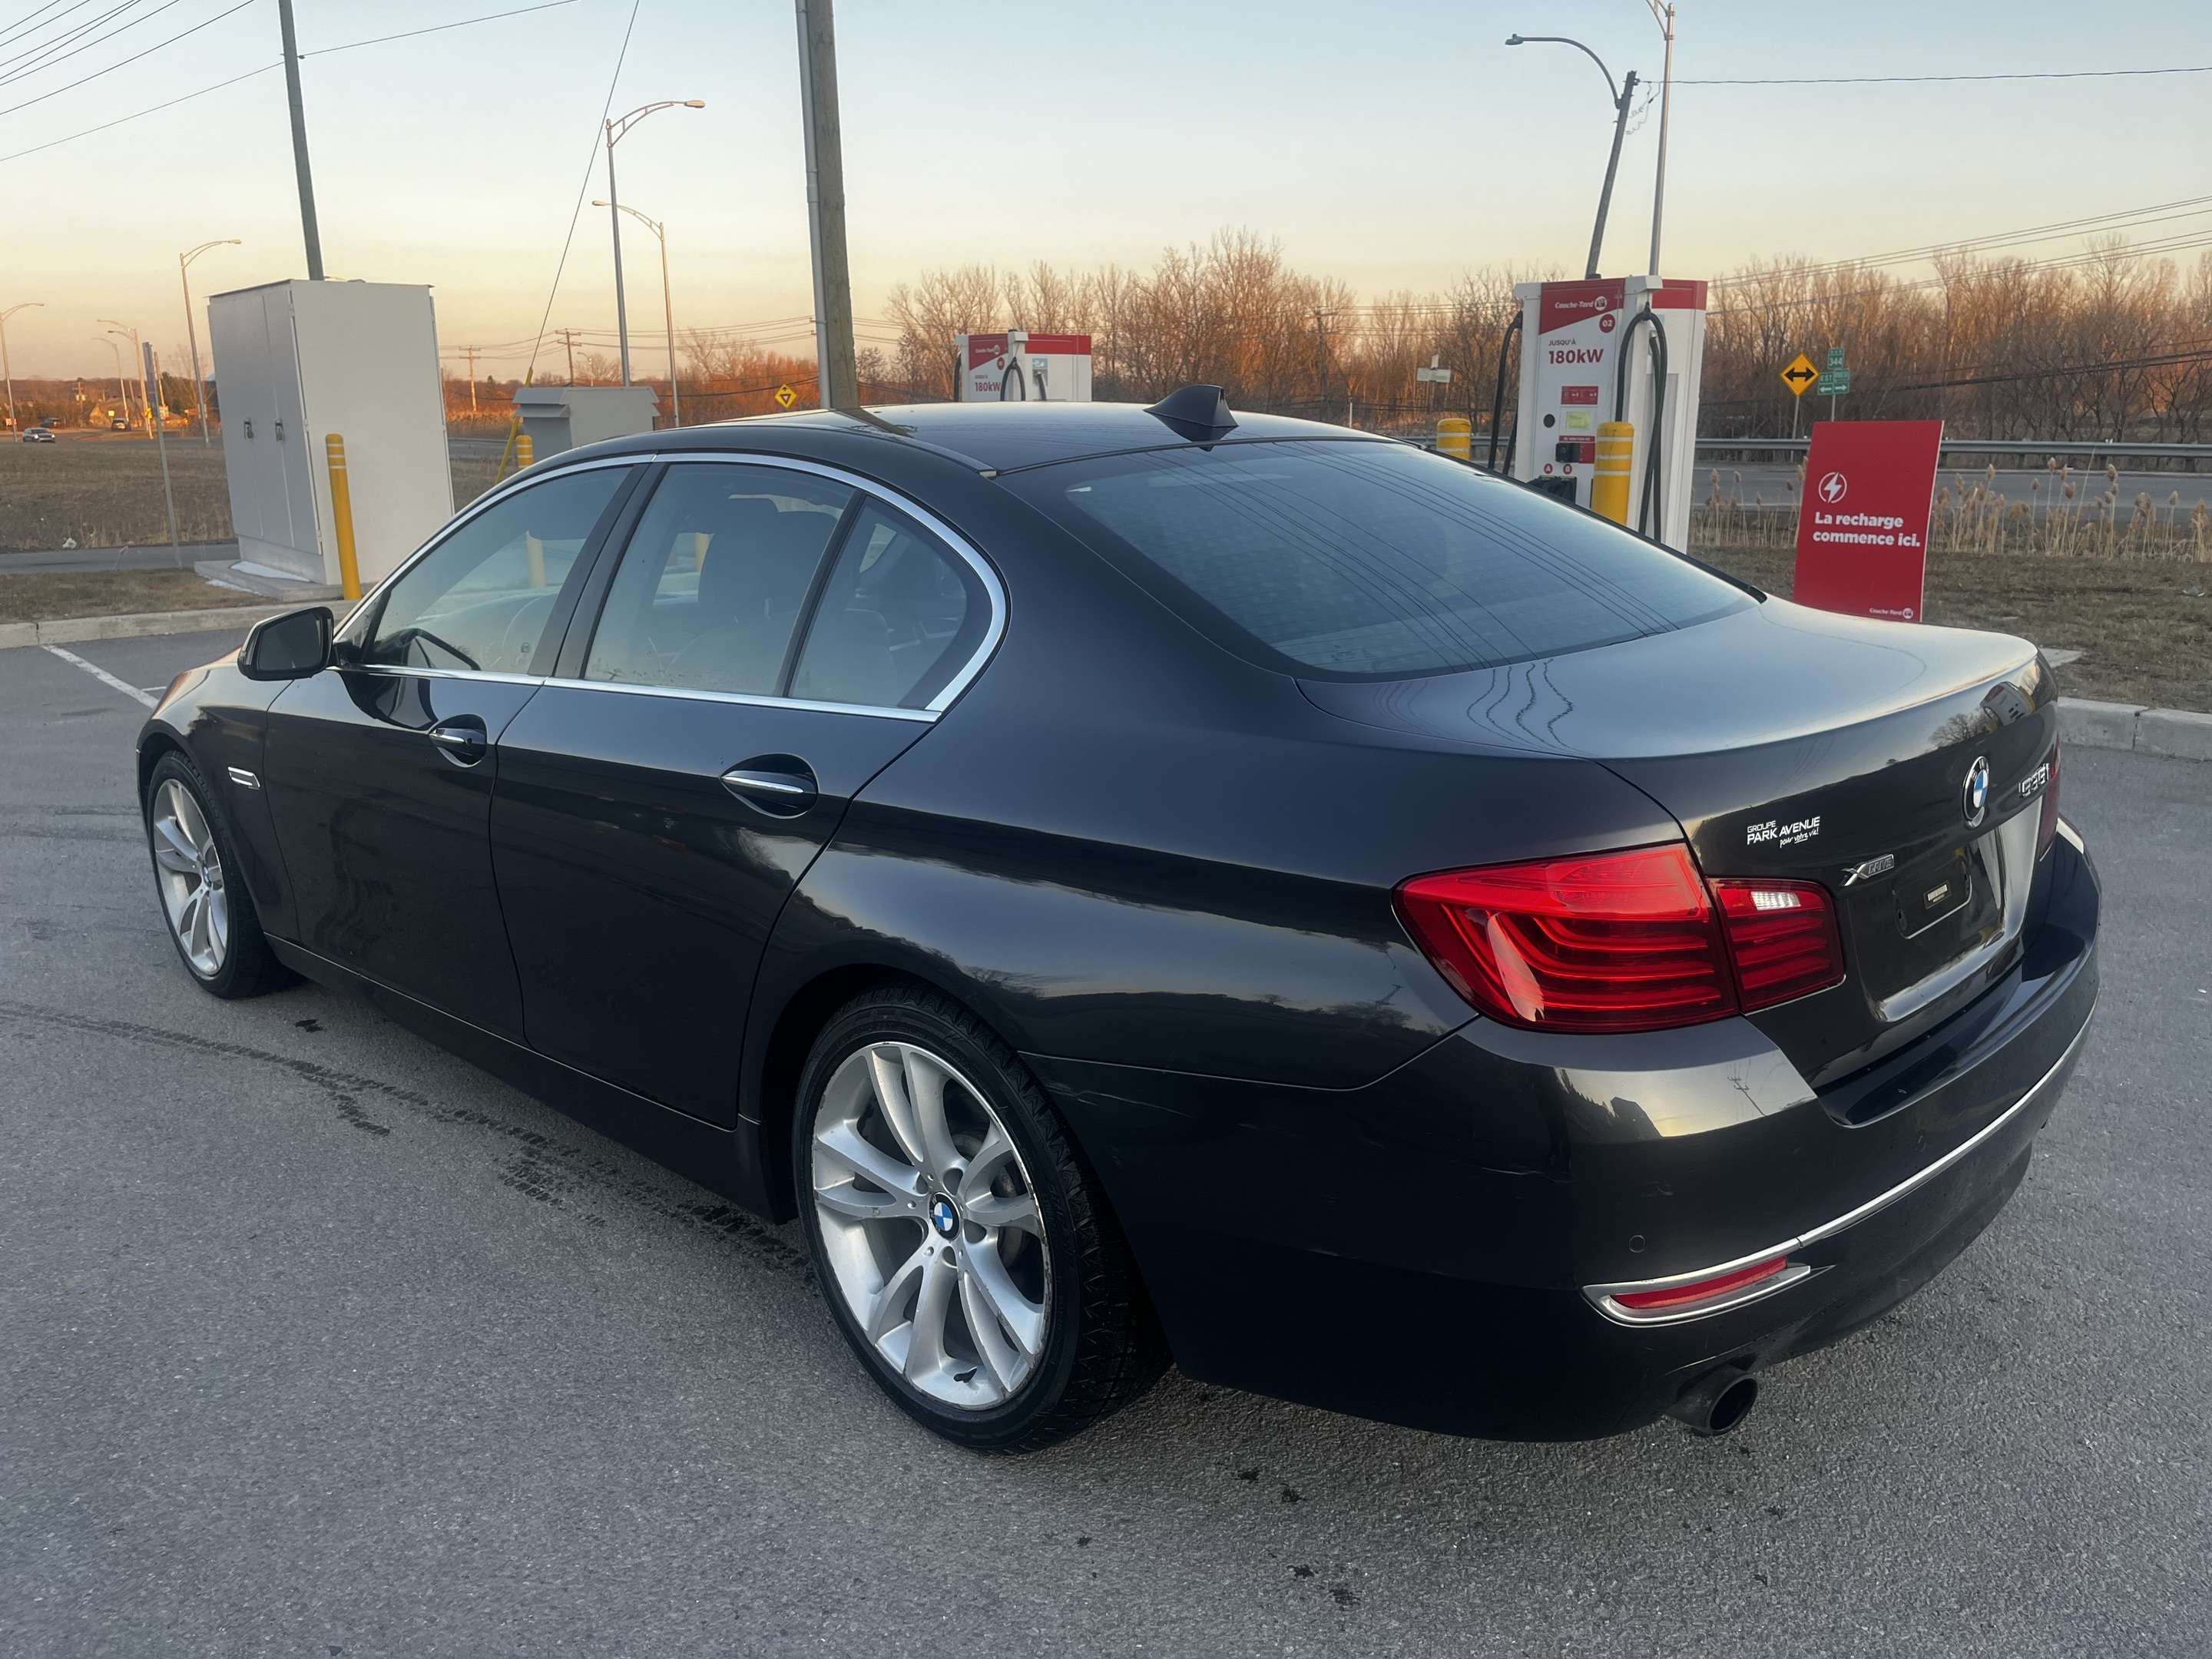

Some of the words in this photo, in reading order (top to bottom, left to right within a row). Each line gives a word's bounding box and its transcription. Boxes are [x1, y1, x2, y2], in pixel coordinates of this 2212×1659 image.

[1548, 349, 1604, 364] 180kW
[975, 382, 1001, 392] 180kW
[1814, 512, 1833, 525] La
[1836, 512, 1904, 530] recharge
[1813, 531, 1896, 546] commence
[1897, 533, 1921, 547] ici.
[1747, 820, 1777, 833] GROUPE
[1747, 827, 1778, 845] PARK
[1779, 816, 1820, 837] AVENUE
[1780, 836, 1793, 849] pour
[1794, 831, 1809, 843] votre
